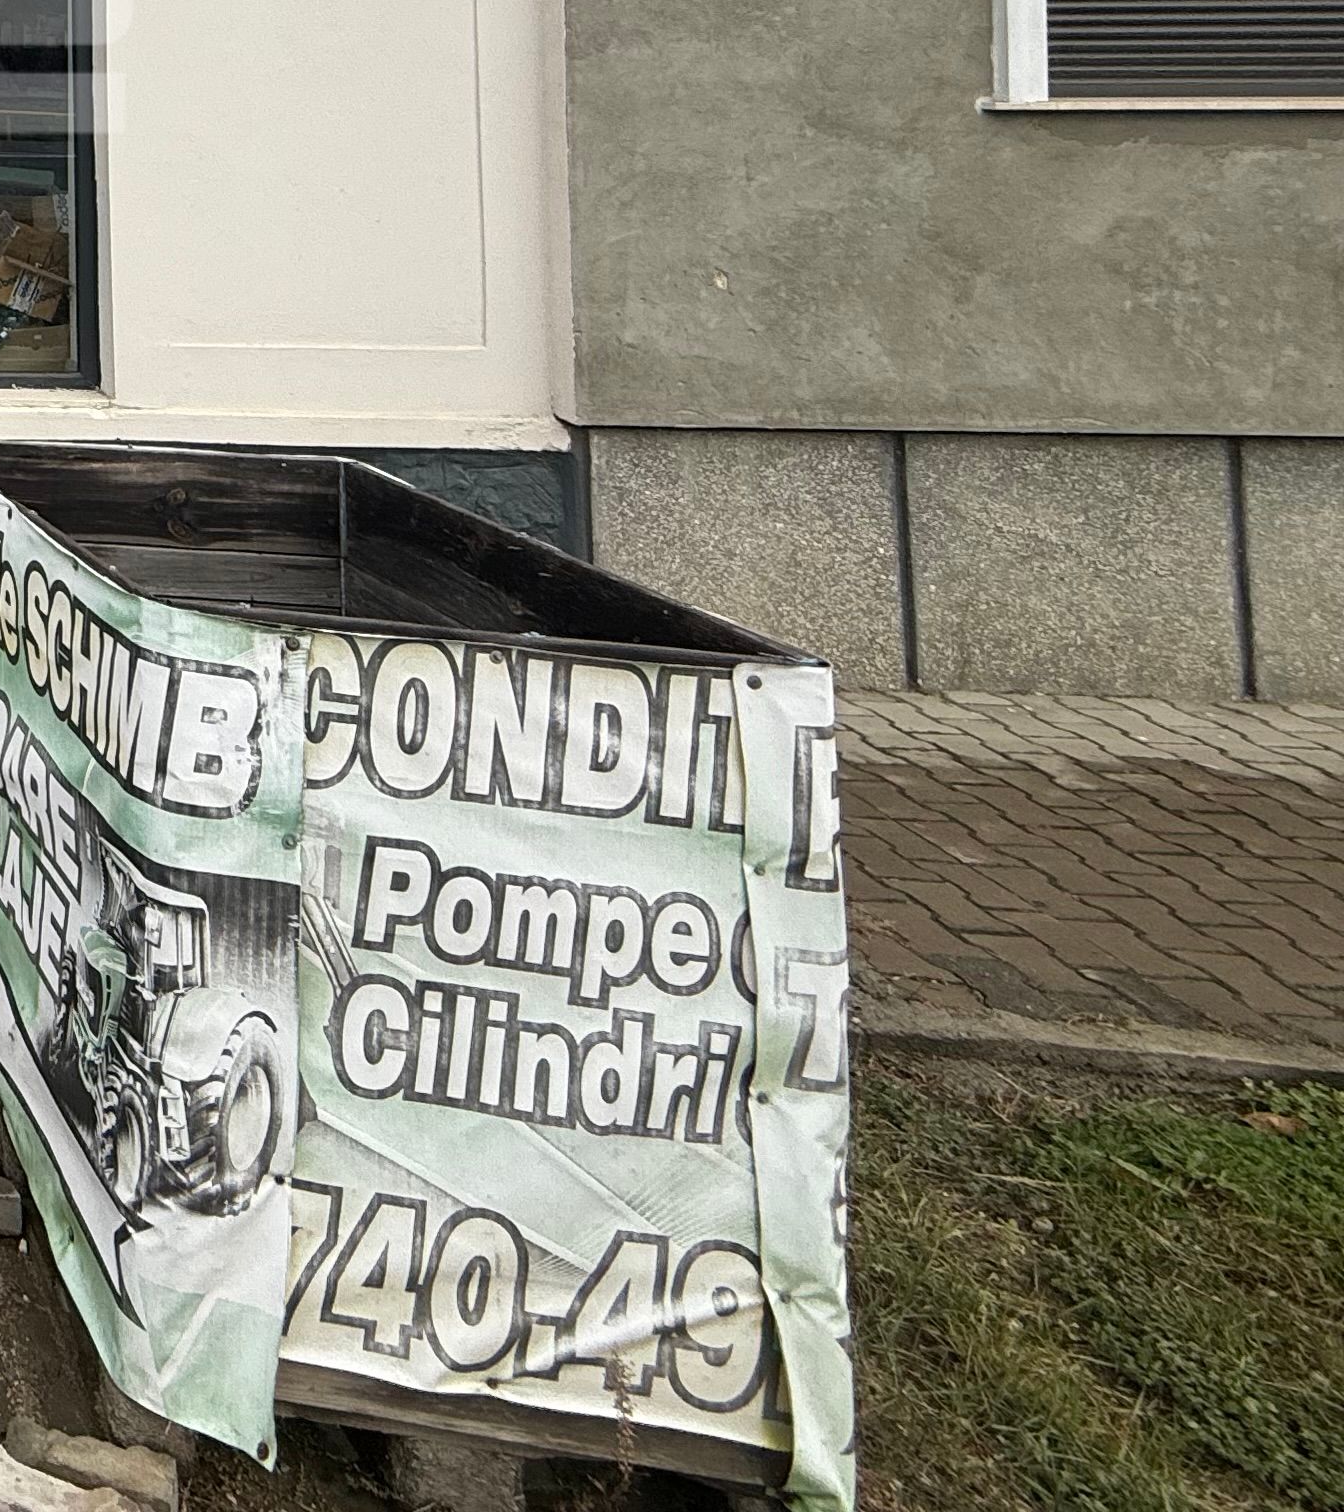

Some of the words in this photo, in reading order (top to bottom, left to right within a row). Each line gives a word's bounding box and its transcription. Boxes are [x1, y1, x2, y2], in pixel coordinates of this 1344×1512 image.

[23, 560, 262, 820] SCHIMB
[352, 835, 722, 1010] Pompe
[327, 974, 742, 1144] Cilindri
[283, 1178, 782, 1420] 740-49
